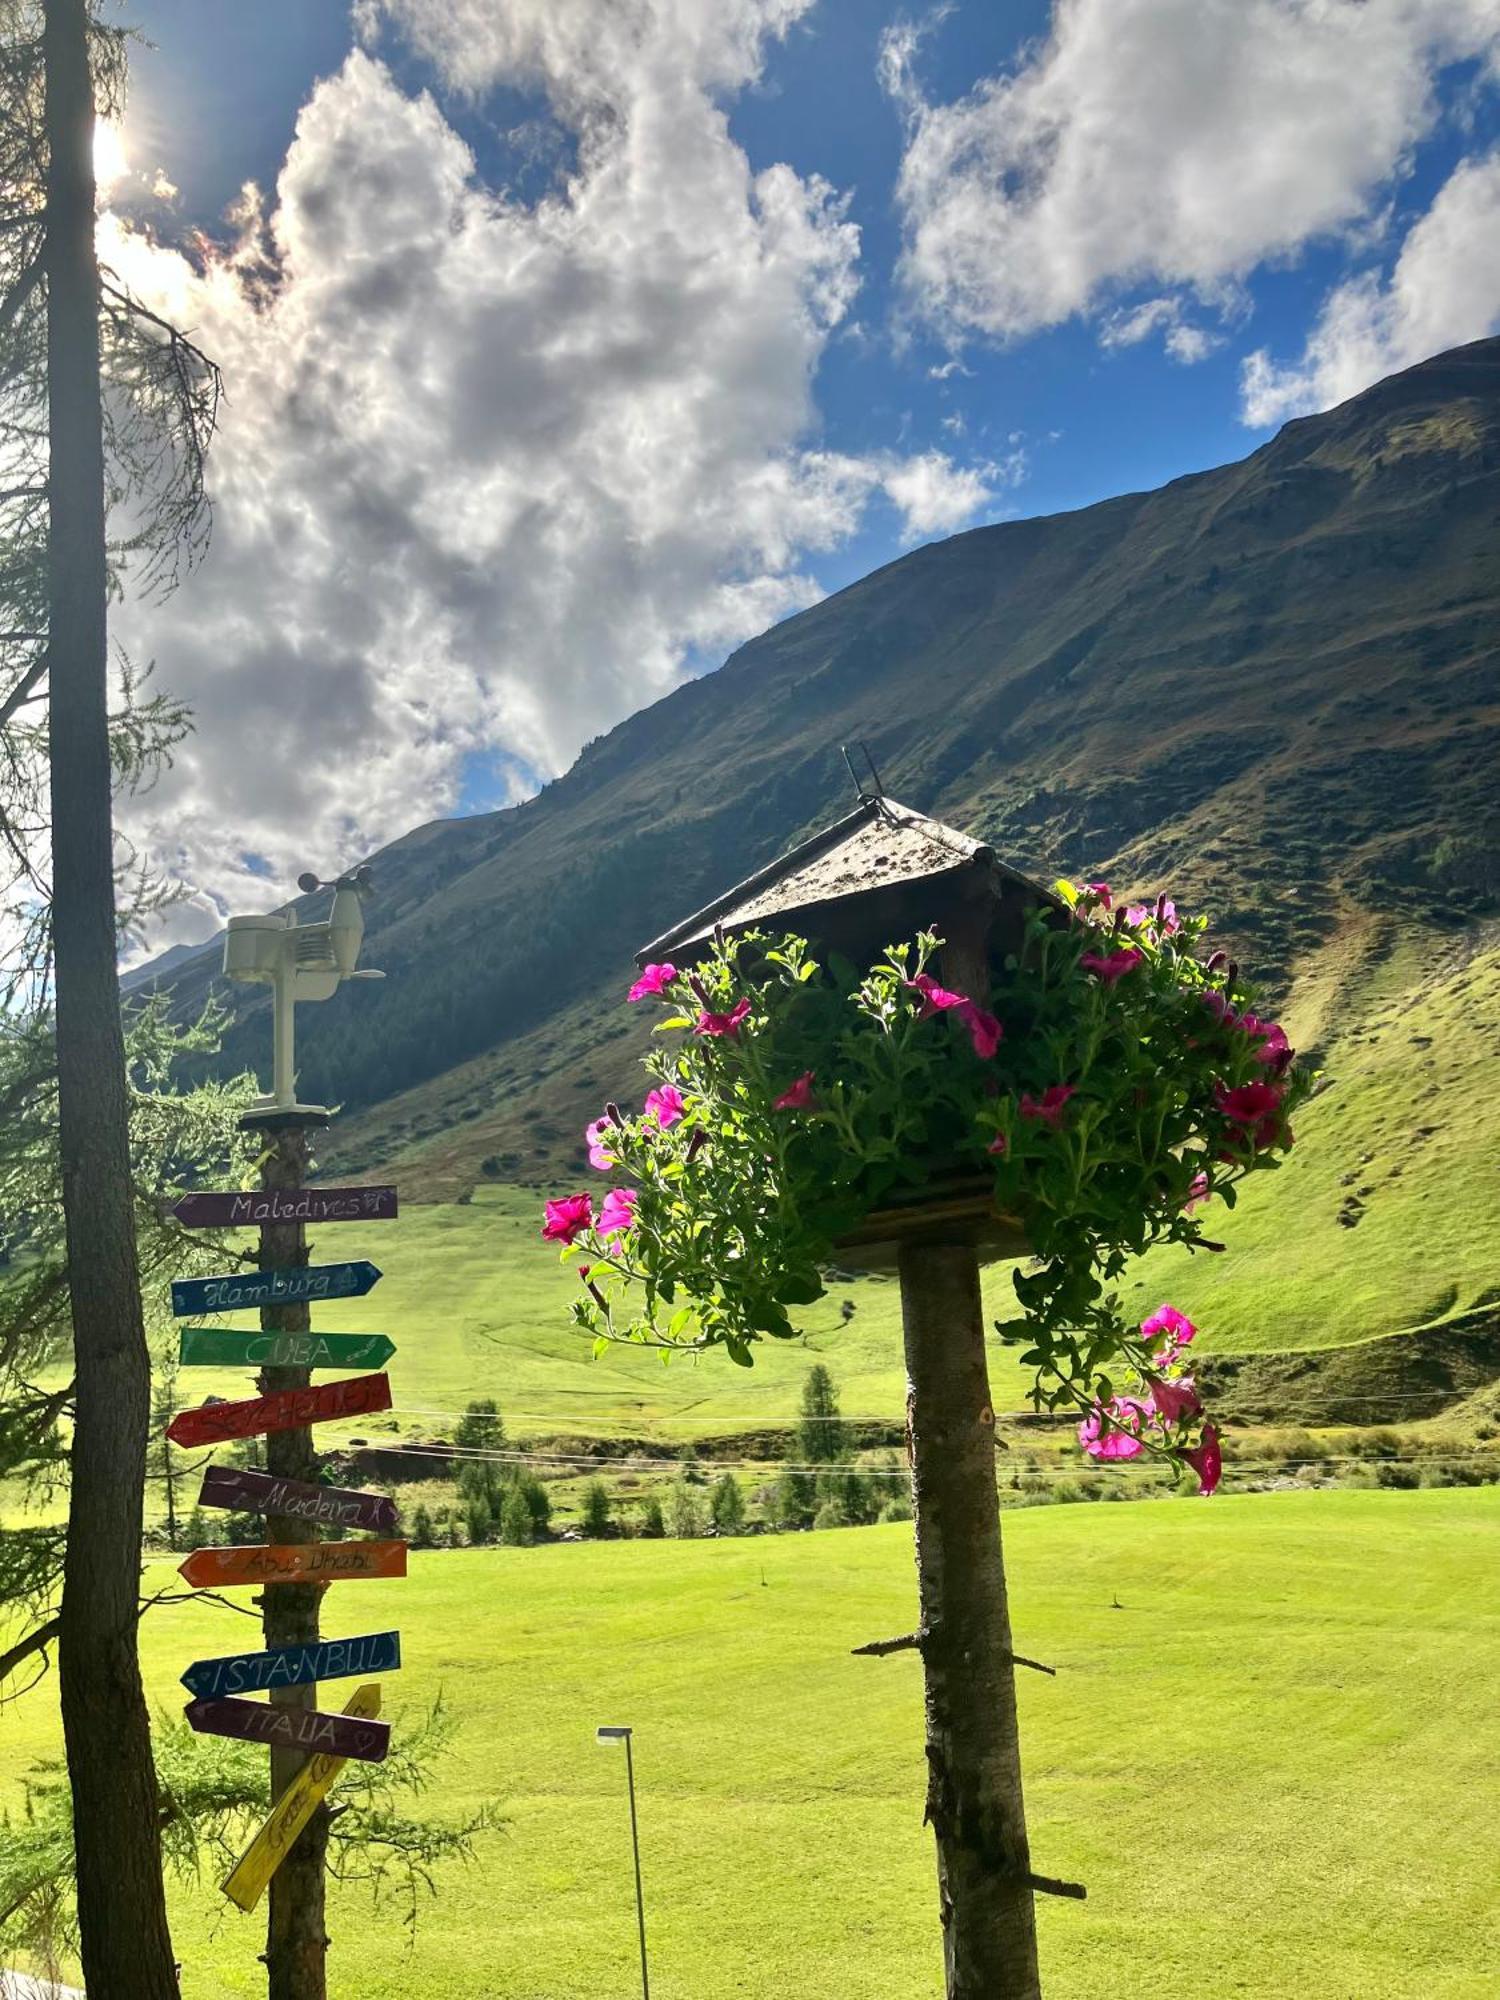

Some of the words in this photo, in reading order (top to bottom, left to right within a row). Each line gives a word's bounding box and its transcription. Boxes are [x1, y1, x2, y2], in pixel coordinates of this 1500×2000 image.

[203, 1271, 331, 1307] Hamburg
[245, 1336, 333, 1365] CUBA
[258, 1482, 361, 1526] Madeira
[244, 1551, 291, 1574] Abu
[306, 1550, 372, 1572] Dhabi
[211, 1640, 383, 1696] ISTANBUL
[244, 1709, 336, 1748] ITALIA
